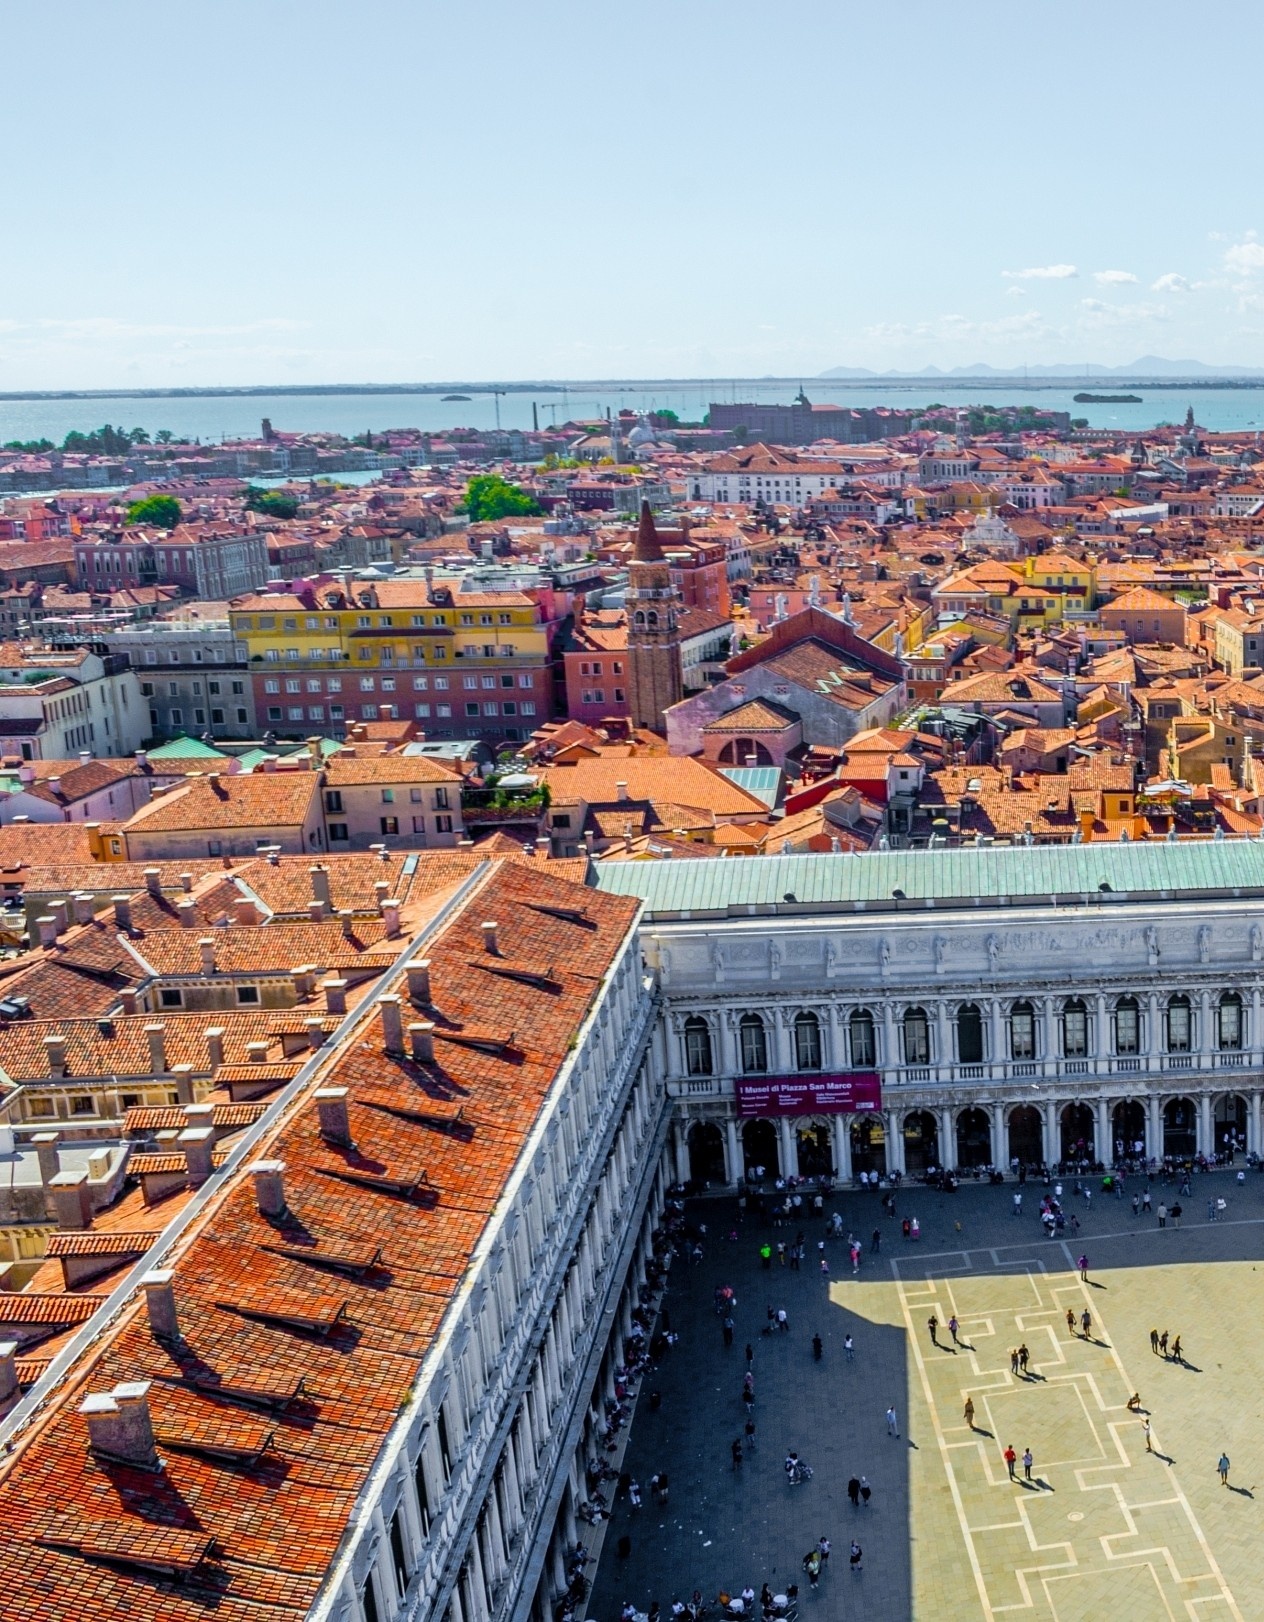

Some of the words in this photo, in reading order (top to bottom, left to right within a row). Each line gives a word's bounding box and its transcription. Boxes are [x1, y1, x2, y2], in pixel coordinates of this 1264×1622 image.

[745, 1085, 769, 1094] Musei
[781, 1084, 808, 1092] Piazza
[809, 1083, 825, 1091] San
[826, 1082, 852, 1090] Marco
